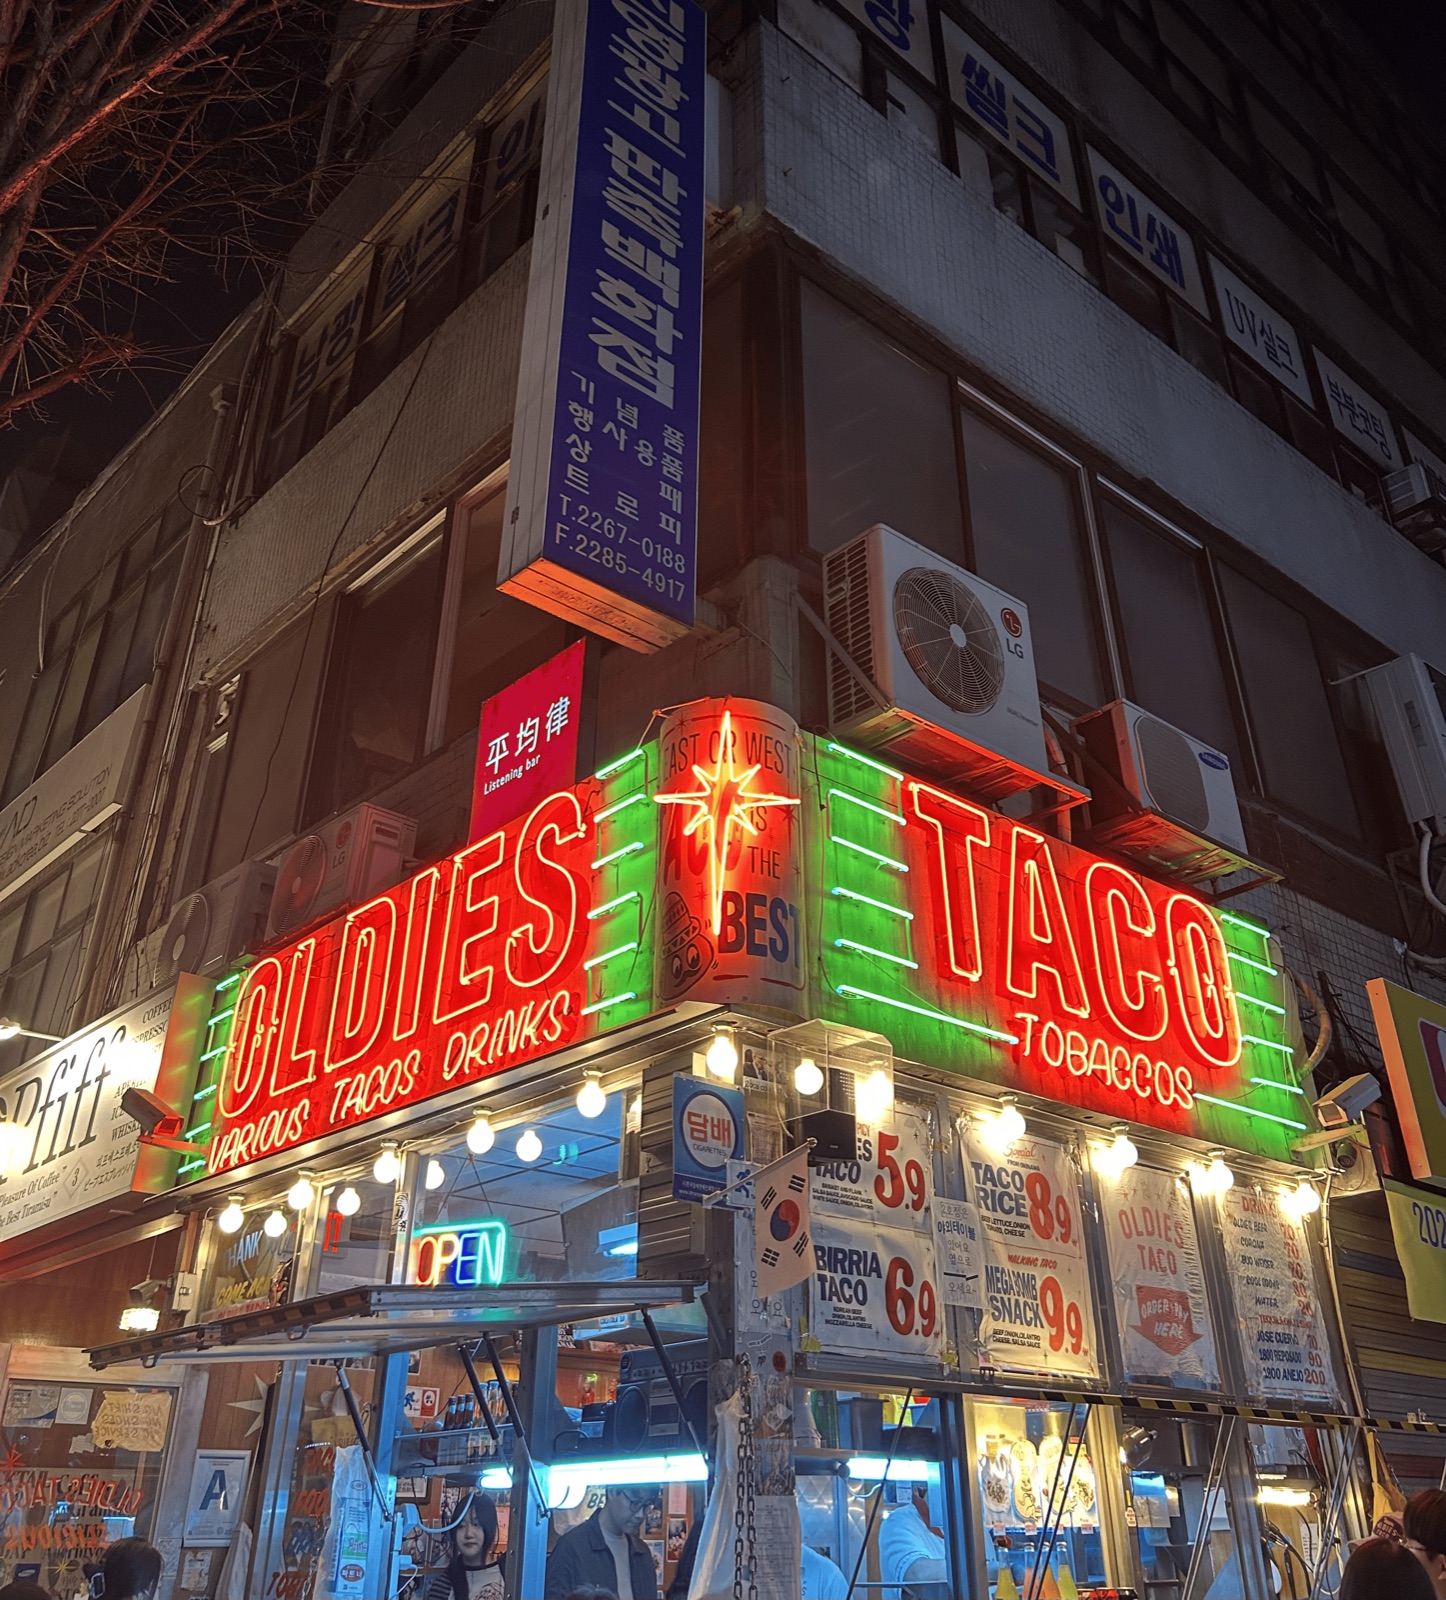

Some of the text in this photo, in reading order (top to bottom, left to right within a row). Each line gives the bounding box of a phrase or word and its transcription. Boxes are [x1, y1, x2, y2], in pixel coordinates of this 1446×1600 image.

[1099, 174, 1186, 292] 인쇄
[1224, 286, 1300, 380] UV실크
[559, 494, 687, 575] T.2267-0188
[555, 522, 686, 603] F.2285-4917
[1006, 637, 1025, 660] LG
[485, 696, 572, 775] 平均律
[745, 730, 793, 780] WEST
[483, 754, 543, 796] Listening bar
[750, 805, 768, 833] IS
[747, 846, 782, 880] THE
[717, 889, 801, 971] BEST
[906, 781, 1243, 1067] TACO
[217, 790, 587, 1120] OLDIES
[1013, 1011, 1195, 1110] TOBACCOS
[206, 989, 573, 1174] VARIOUS TACOS DRINKS
[686, 1109, 732, 1150] 담배
[692, 1142, 728, 1158] CIGARETTES
[873, 1130, 926, 1212] 5.9
[1003, 1141, 1038, 1161] Special
[71, 1167, 81, 1188] 3
[970, 1160, 1025, 1193] TACO
[974, 1184, 1029, 1219] RICE
[1024, 1171, 1072, 1245] 8.9
[937, 1220, 977, 1242] 야외테이블
[1004, 1228, 1026, 1239] CHEESE
[1118, 1205, 1184, 1250] OLDIES
[415, 1231, 504, 1286] OPEN
[814, 1244, 883, 1282] BIRRIA
[1007, 1253, 1058, 1270] WALKING TACO
[1136, 1243, 1178, 1276] TACO
[215, 1280, 249, 1307] COME
[816, 1273, 869, 1307] TACO
[884, 1256, 937, 1338] 6.9
[1255, 1295, 1279, 1309] WATER
[988, 1294, 1045, 1329] SNACK
[1039, 1275, 1083, 1356] 9.9
[1153, 1320, 1185, 1339] HERE
[1257, 1329, 1275, 1345] JOSE
[198, 1469, 230, 1511] A
